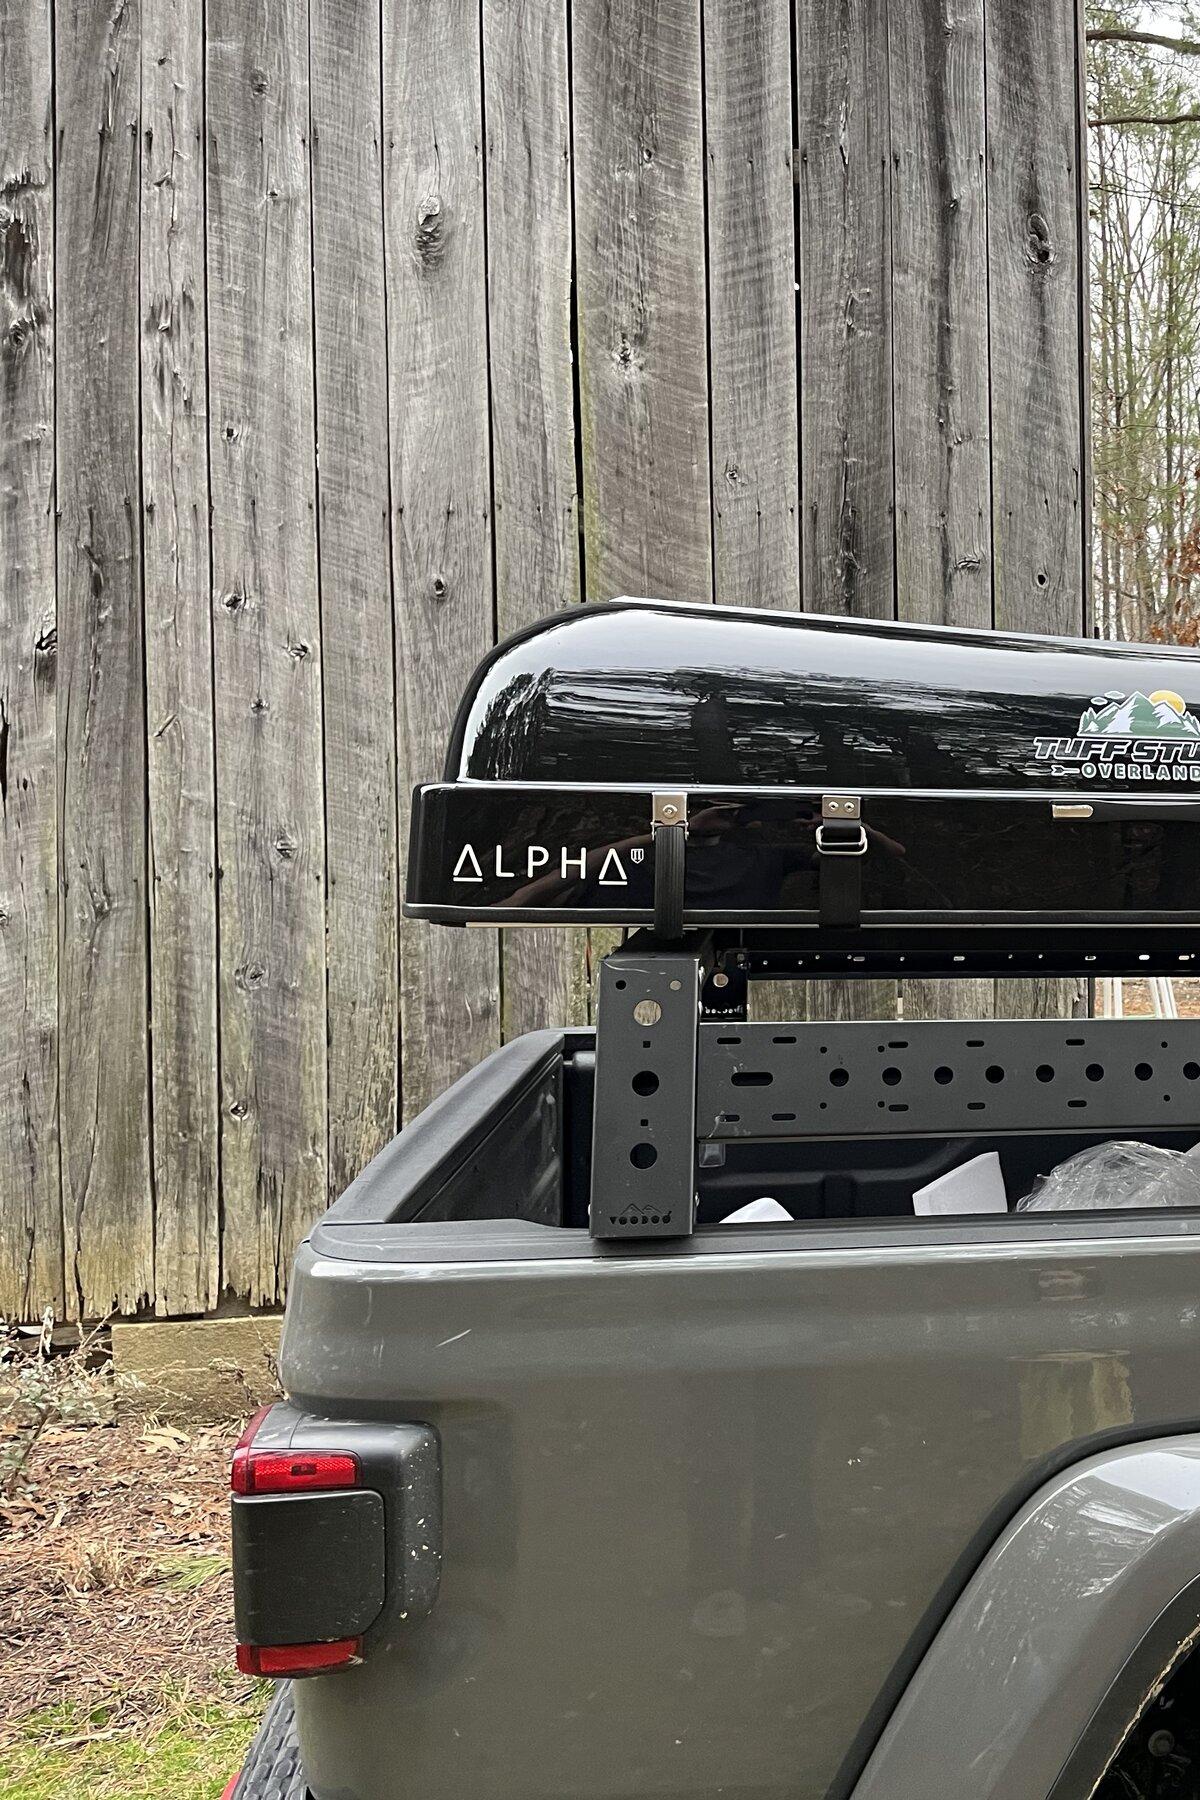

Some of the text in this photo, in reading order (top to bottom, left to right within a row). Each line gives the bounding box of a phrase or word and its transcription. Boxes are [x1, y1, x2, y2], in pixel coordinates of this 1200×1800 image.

[1033, 737, 1131, 760] TUFF
[453, 843, 628, 885] ALPHA
[609, 1211, 672, 1225] VOODOO
